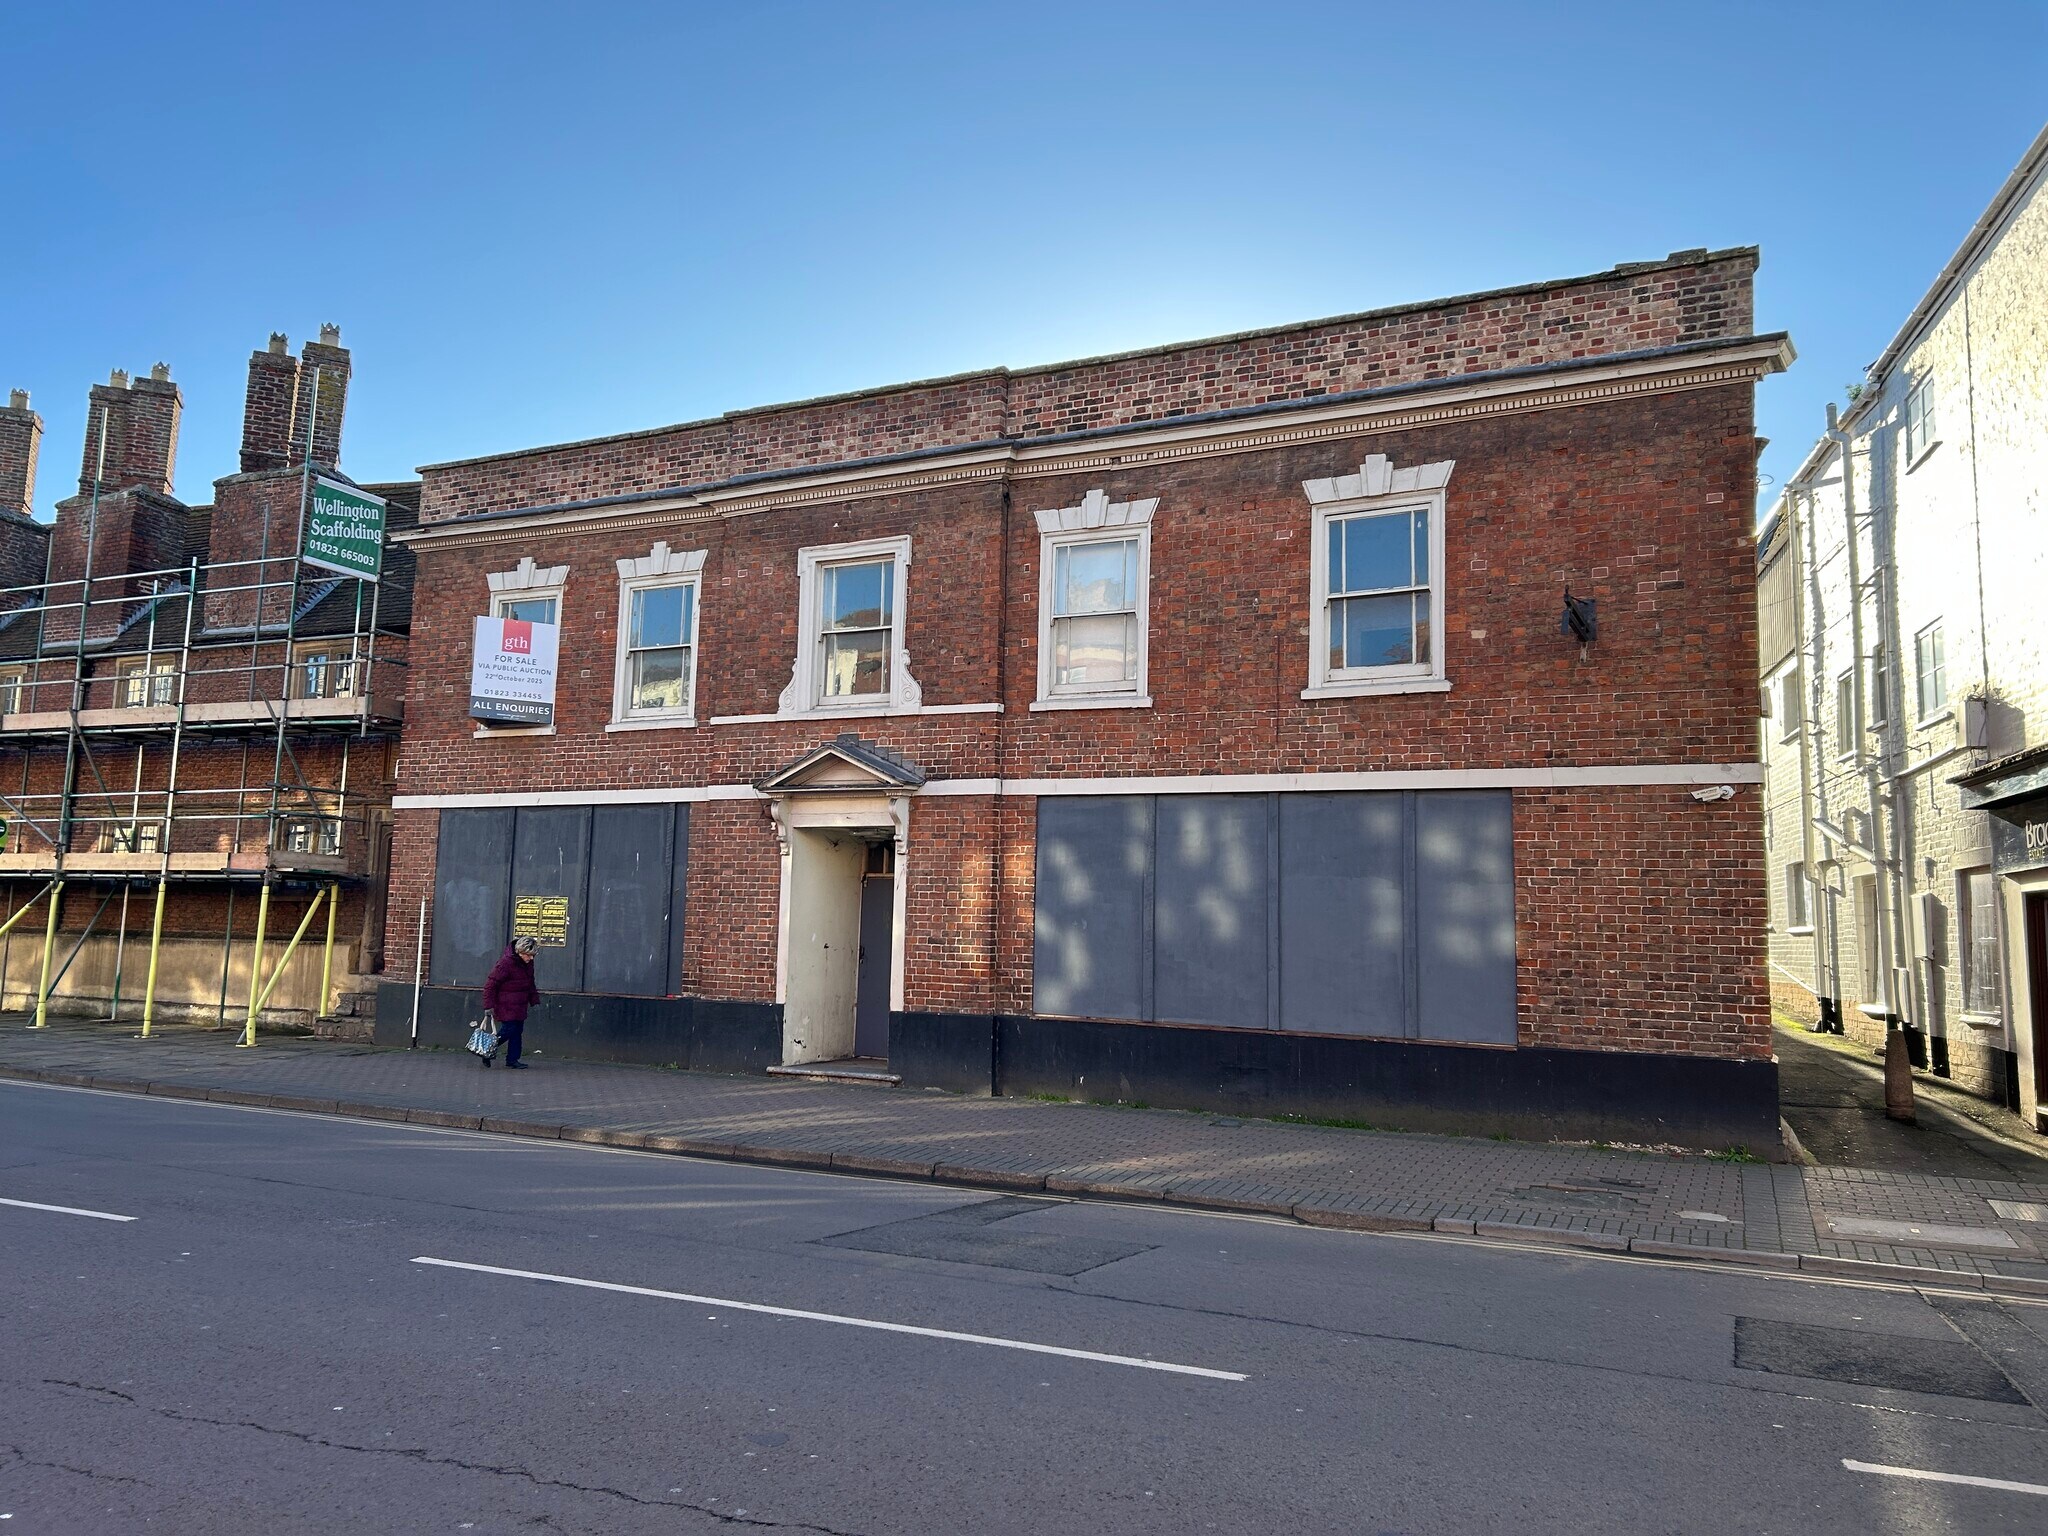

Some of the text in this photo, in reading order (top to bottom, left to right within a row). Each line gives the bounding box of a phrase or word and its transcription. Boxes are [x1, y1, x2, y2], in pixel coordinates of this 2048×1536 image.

[313, 497, 379, 521] Wellington
[311, 518, 382, 544] Scaffolding
[309, 539, 375, 566] 01823 665003
[504, 636, 528, 650] gth
[494, 655, 537, 665] FOR SALE
[492, 664, 518, 672] PUBLIC
[519, 667, 552, 676] AUCTION
[484, 688, 542, 700] 01823 334455
[473, 701, 550, 715] ALL ENQUIRIES
